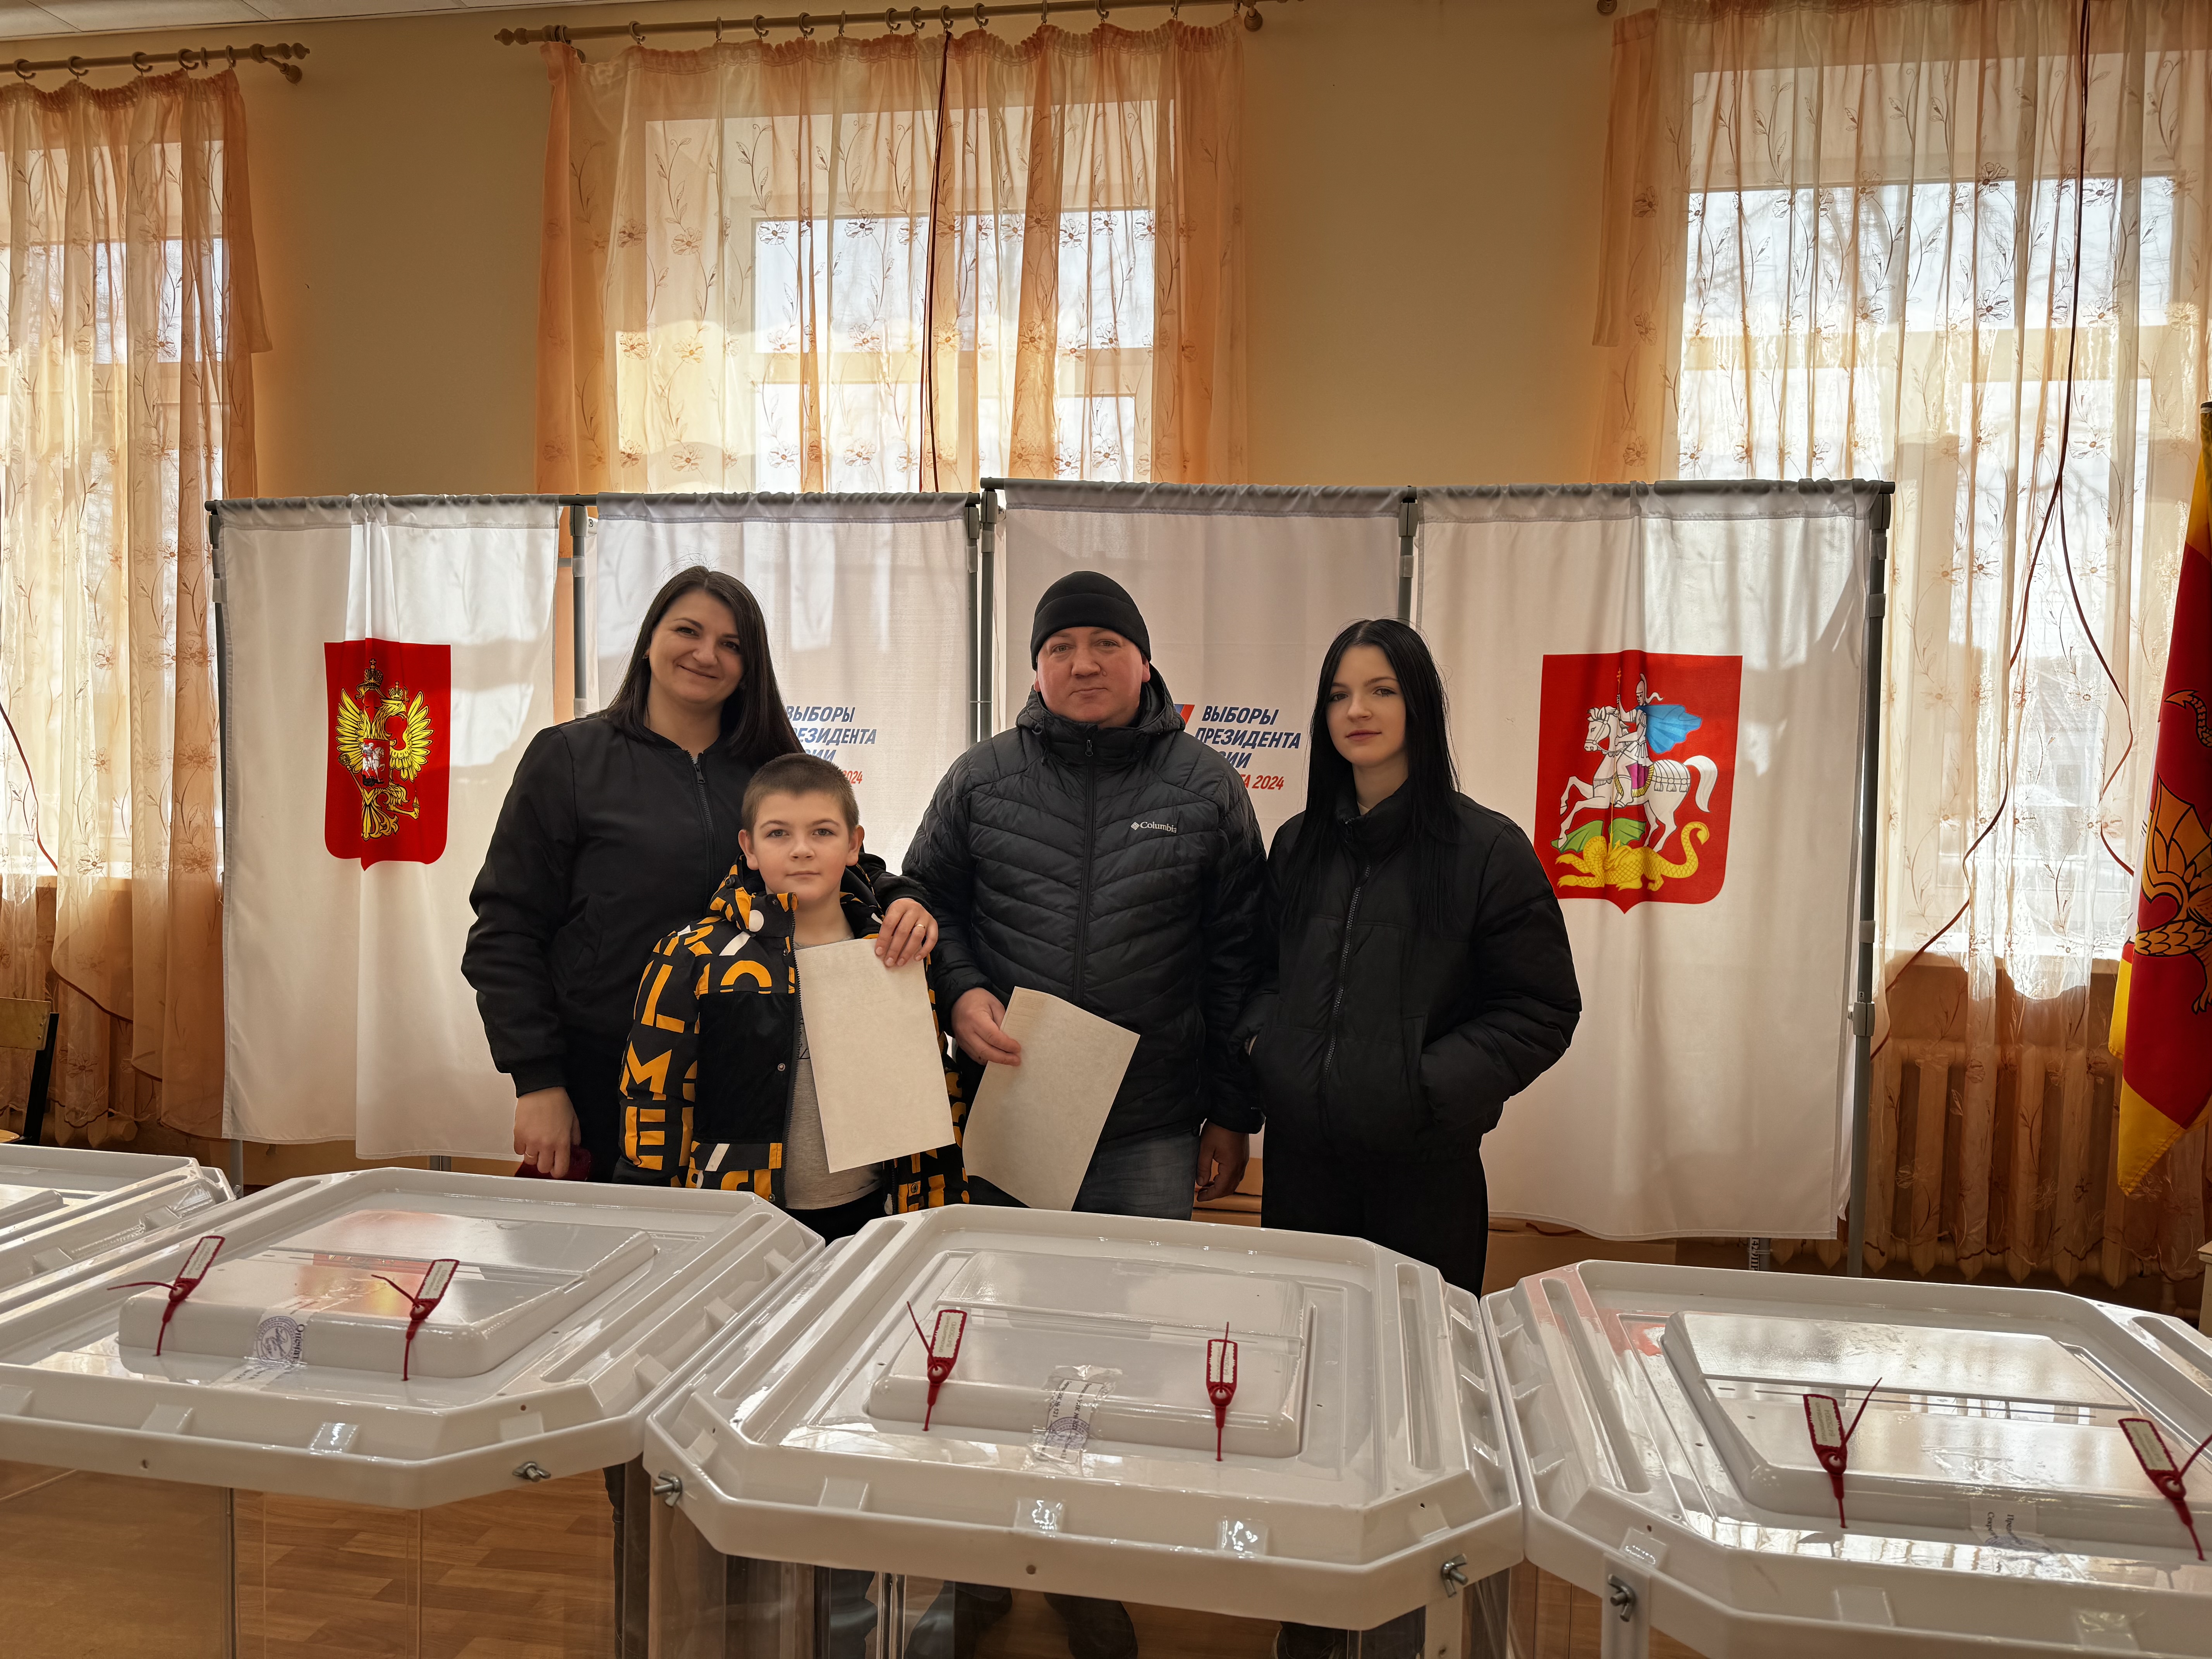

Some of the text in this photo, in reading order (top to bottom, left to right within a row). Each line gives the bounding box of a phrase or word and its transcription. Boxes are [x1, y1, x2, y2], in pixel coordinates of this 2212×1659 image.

[787, 706, 855, 722] ВЫБОРЫ
[1202, 706, 1279, 725] ВЫБОРЫ
[1195, 727, 1302, 749] ПРЕЗИДЕНТА
[1252, 775, 1285, 790] 2024
[1140, 821, 1177, 833] Columbia
